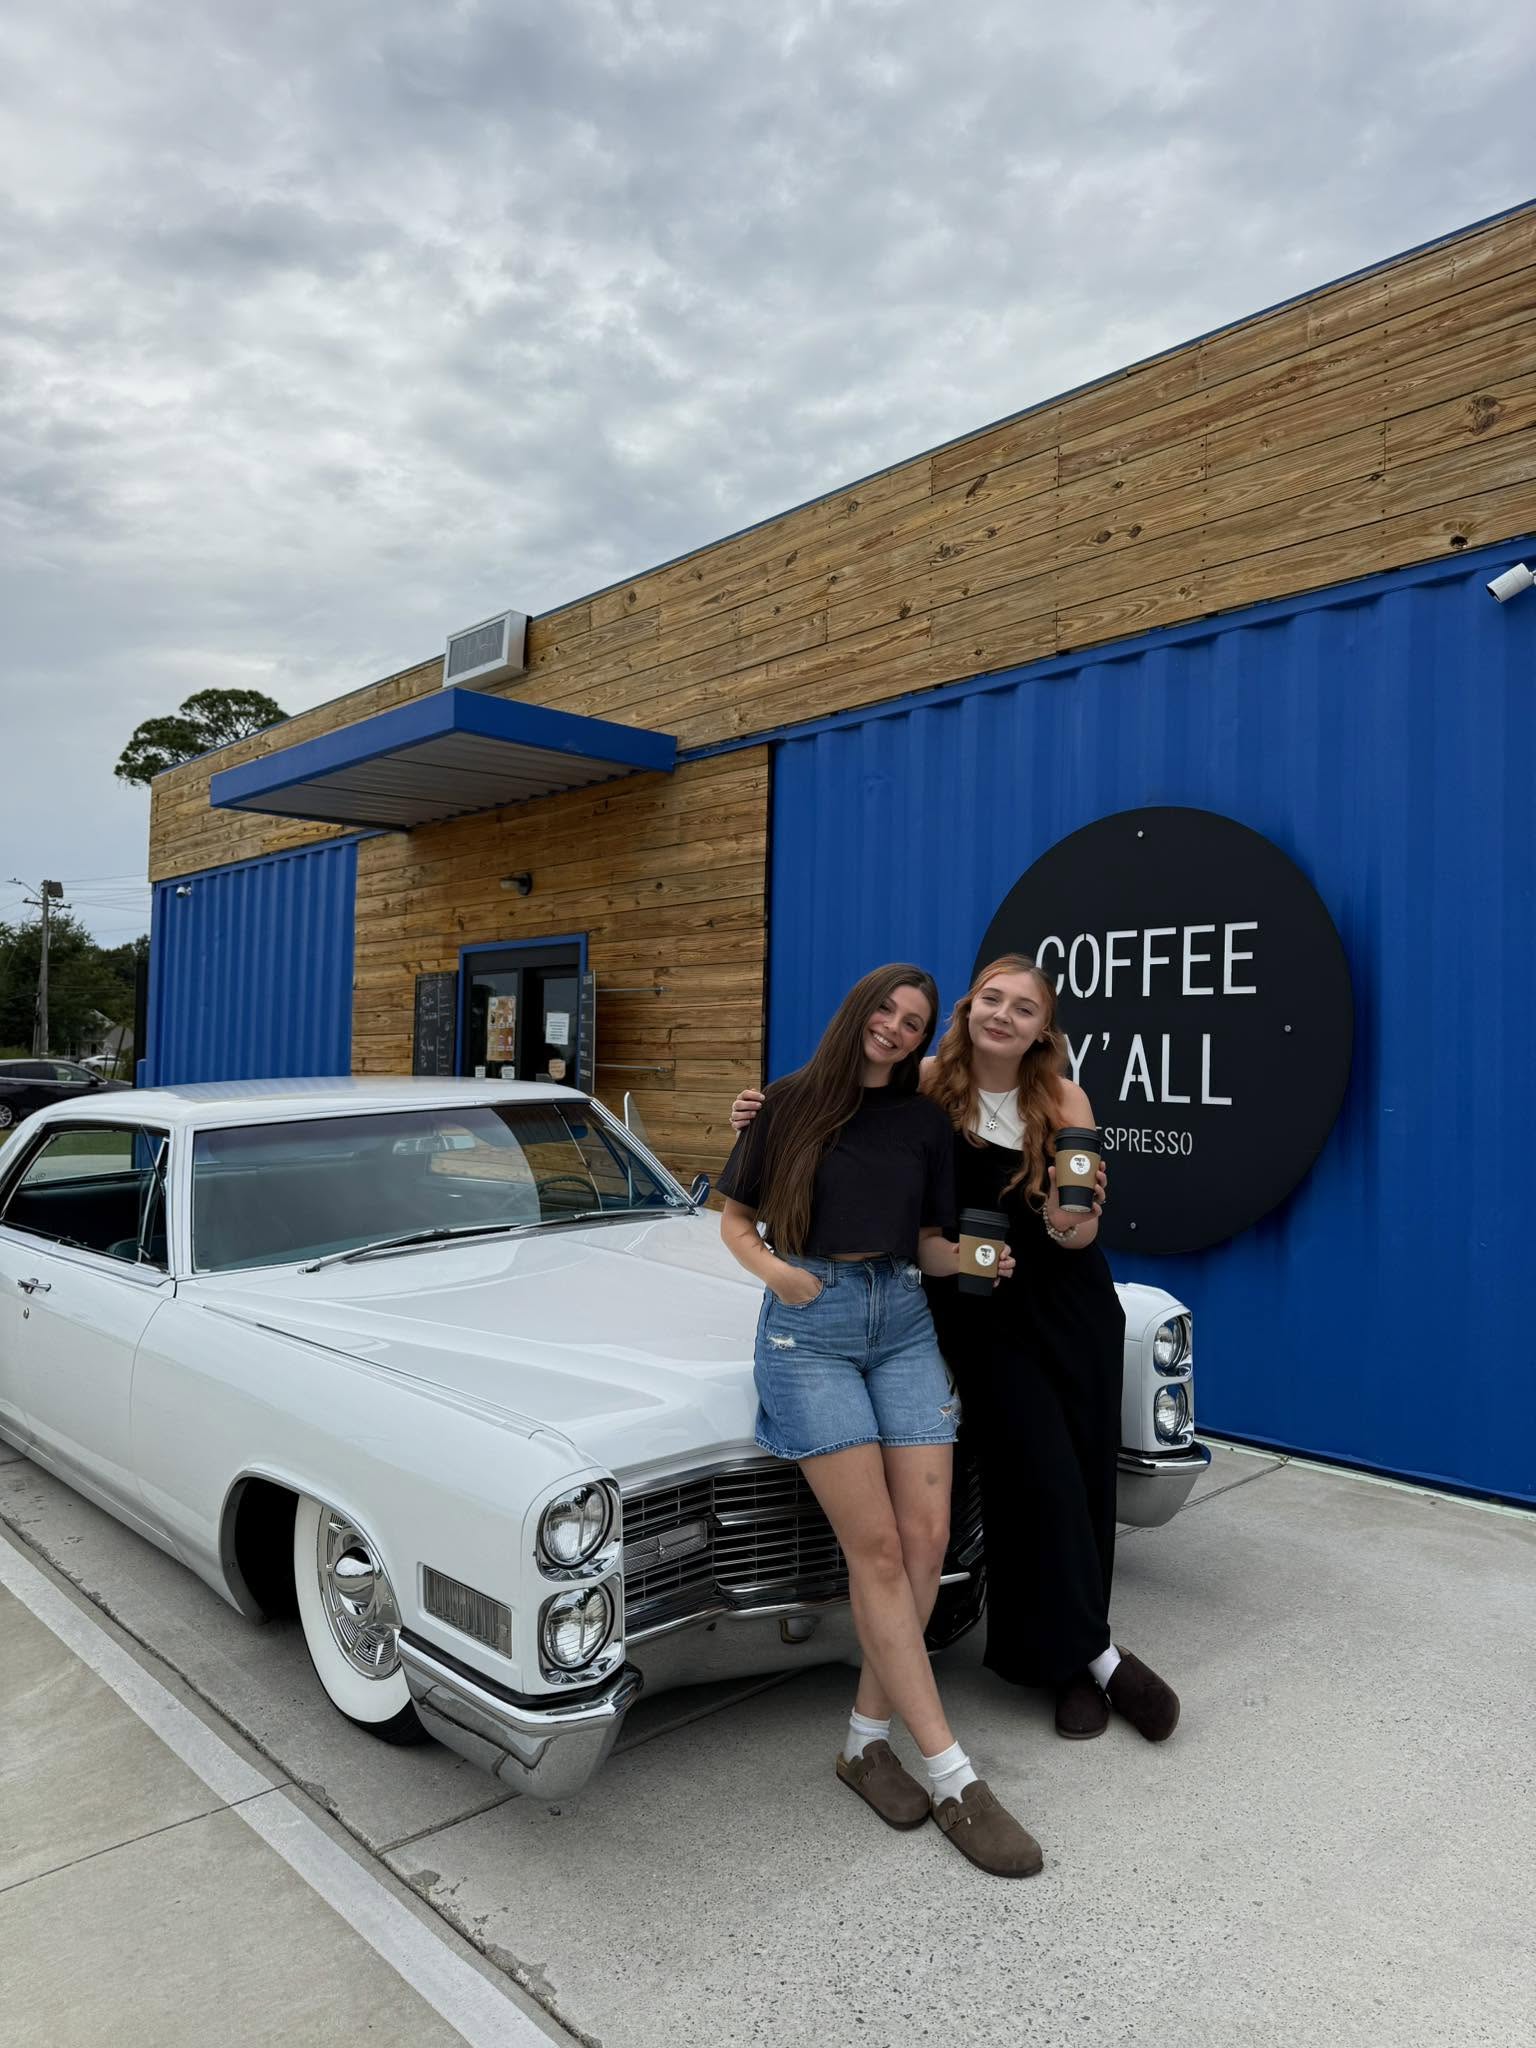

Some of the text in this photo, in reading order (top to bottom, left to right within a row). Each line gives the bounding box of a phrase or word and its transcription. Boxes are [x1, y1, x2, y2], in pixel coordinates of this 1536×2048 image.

[1035, 921, 1258, 998] COFFEE
[1064, 1032, 1232, 1105] Y'ALL
[1096, 1126, 1193, 1156] SPRESSO
